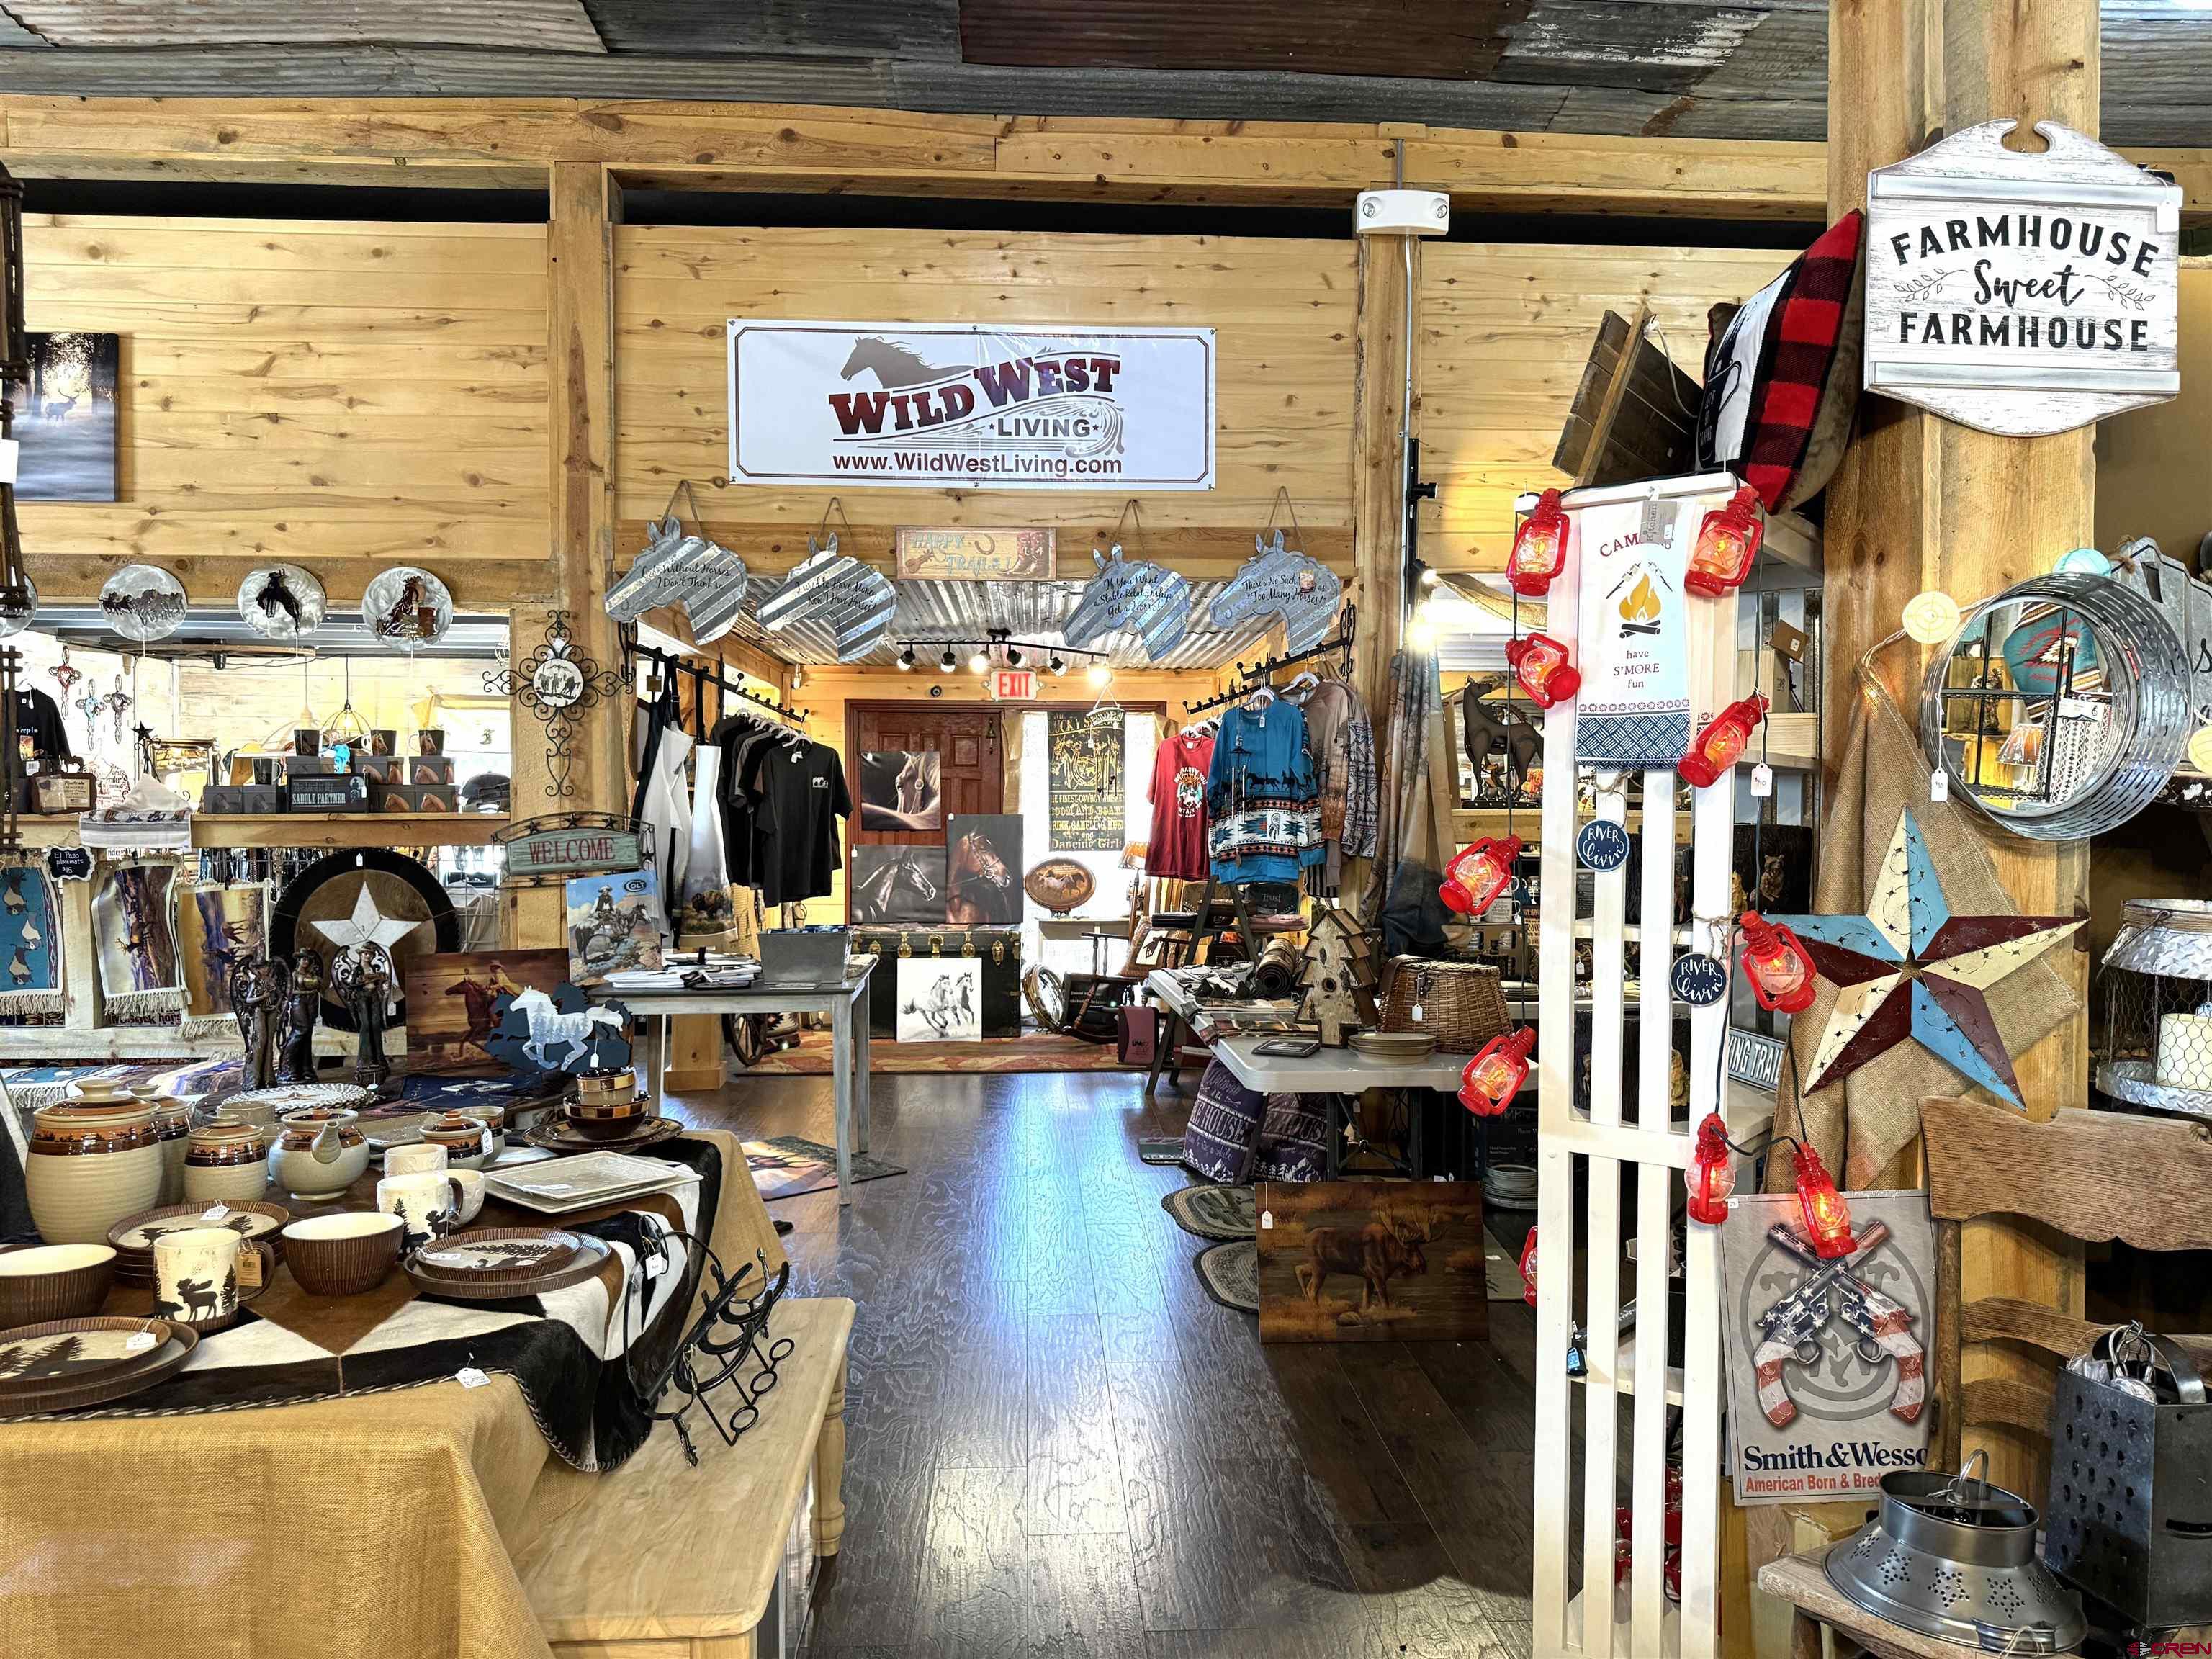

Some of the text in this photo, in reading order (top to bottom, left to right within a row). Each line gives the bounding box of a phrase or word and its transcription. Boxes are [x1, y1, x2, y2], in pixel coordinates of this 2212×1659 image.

[1890, 215, 2160, 278] FARMHOUSE
[1974, 259, 2085, 307] Sweet
[1899, 312, 2149, 351] FARMHOUSE
[828, 356, 1121, 435] WILD WEST
[997, 418, 1091, 438] LIVING
[832, 451, 1123, 477] www.WildWestLiving.com
[911, 533, 966, 549] HAPPY
[663, 562, 700, 574] Without
[663, 577, 686, 588] Don't
[688, 576, 711, 588] Think
[831, 576, 851, 590] Have
[1104, 575, 1159, 591] If You Want
[1242, 578, 1267, 590] There's
[1269, 577, 1278, 586] No
[1280, 573, 1297, 585] Such
[830, 592, 848, 605] Have
[1100, 590, 1124, 606] Stable
[1267, 588, 1291, 604] Many
[1626, 650, 1649, 660] have
[1613, 662, 1660, 677] S'MORE
[999, 673, 1031, 697] EXIT
[1627, 679, 1645, 689] fun
[292, 793, 346, 804] SADDLE PARTNER
[1588, 824, 1620, 843] RIVER
[529, 836, 616, 865] WELCOME
[1681, 958, 1717, 976] RIVER
[1745, 1472, 1881, 1493] American Born & Bred
